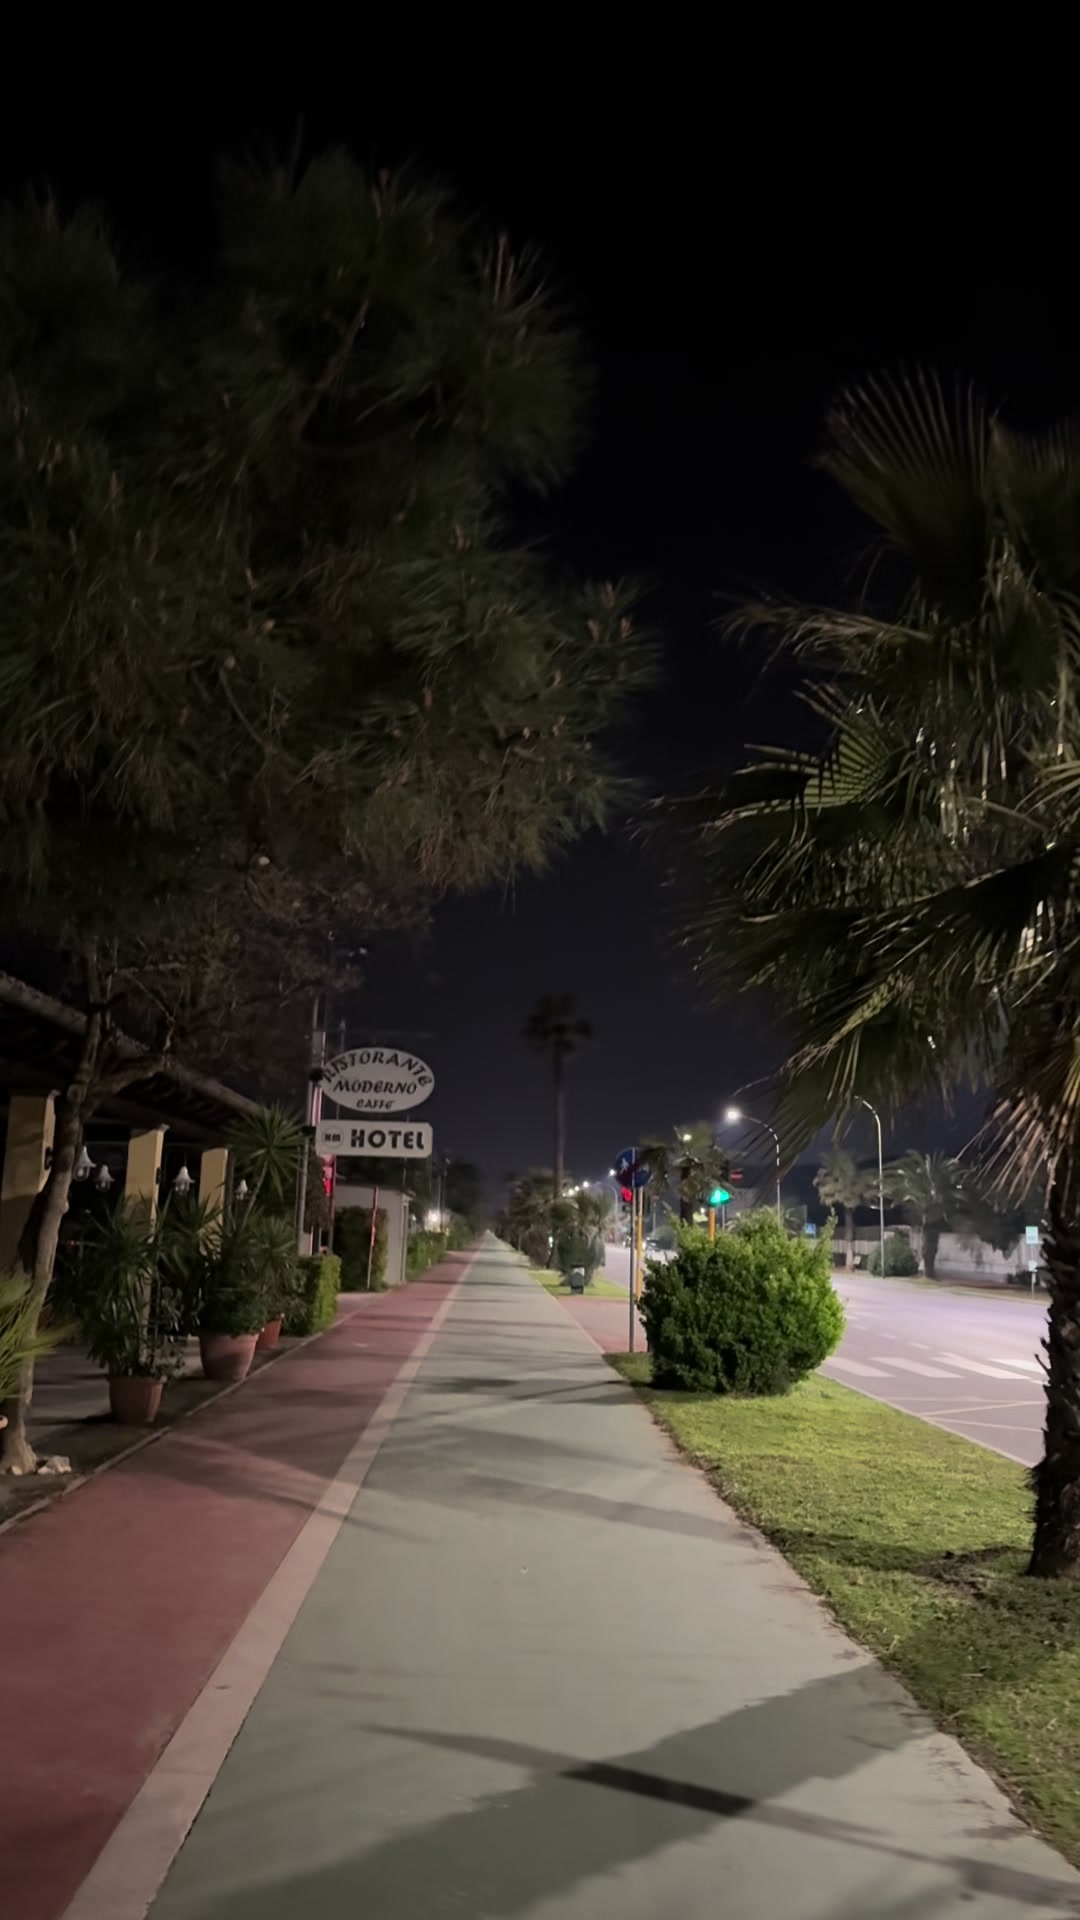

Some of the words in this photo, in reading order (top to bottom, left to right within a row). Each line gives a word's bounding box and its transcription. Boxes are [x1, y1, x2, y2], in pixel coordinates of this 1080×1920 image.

[323, 1050, 432, 1087] RISTORANTE
[333, 1080, 418, 1095] MODERNO
[350, 1129, 424, 1149] HOTEL
